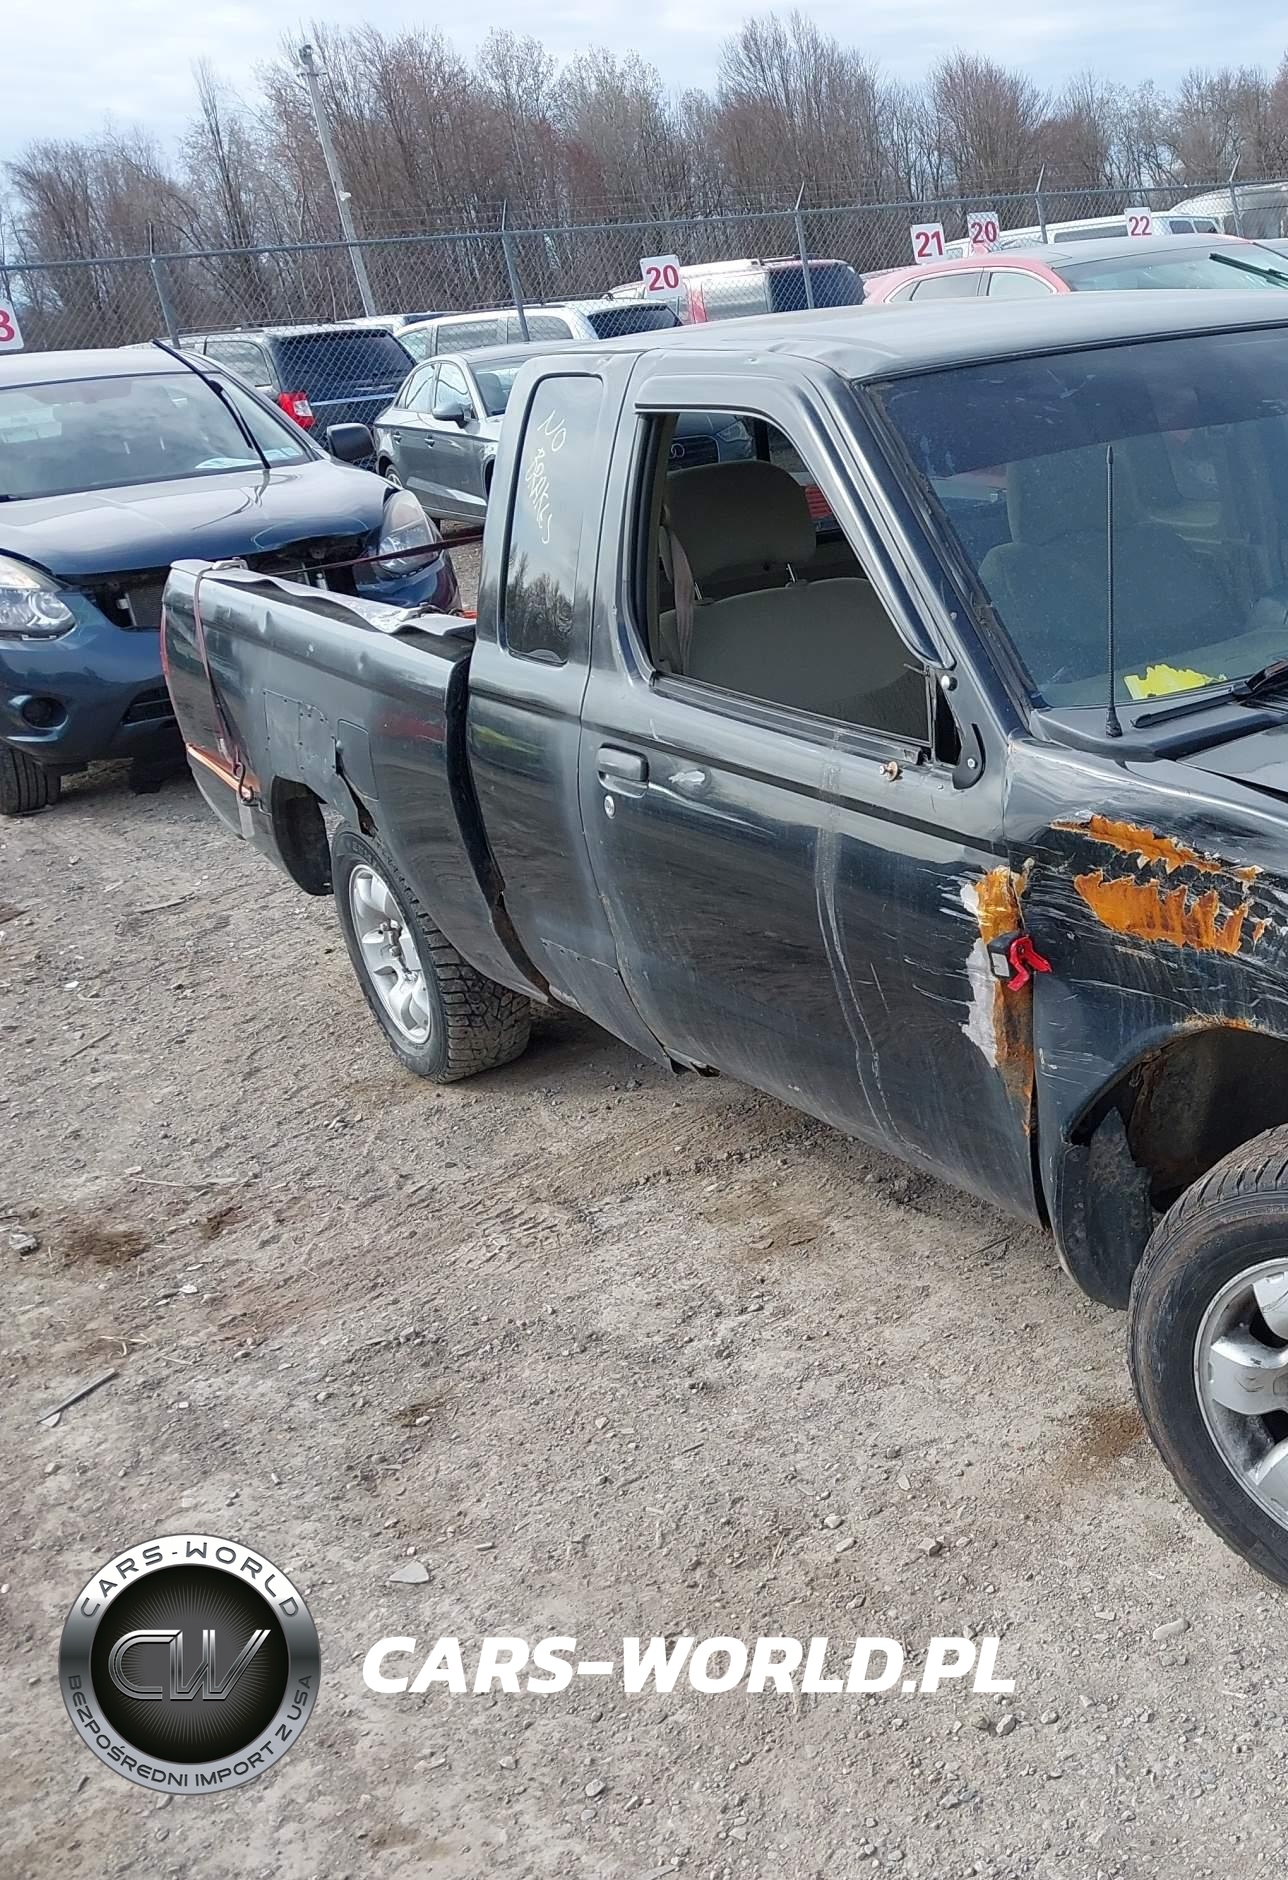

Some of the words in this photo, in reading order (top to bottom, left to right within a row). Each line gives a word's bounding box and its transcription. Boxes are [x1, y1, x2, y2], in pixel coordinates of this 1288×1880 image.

[971, 221, 997, 244] 20
[1129, 216, 1152, 236] 22
[915, 230, 943, 257] 21
[646, 265, 679, 291] 20
